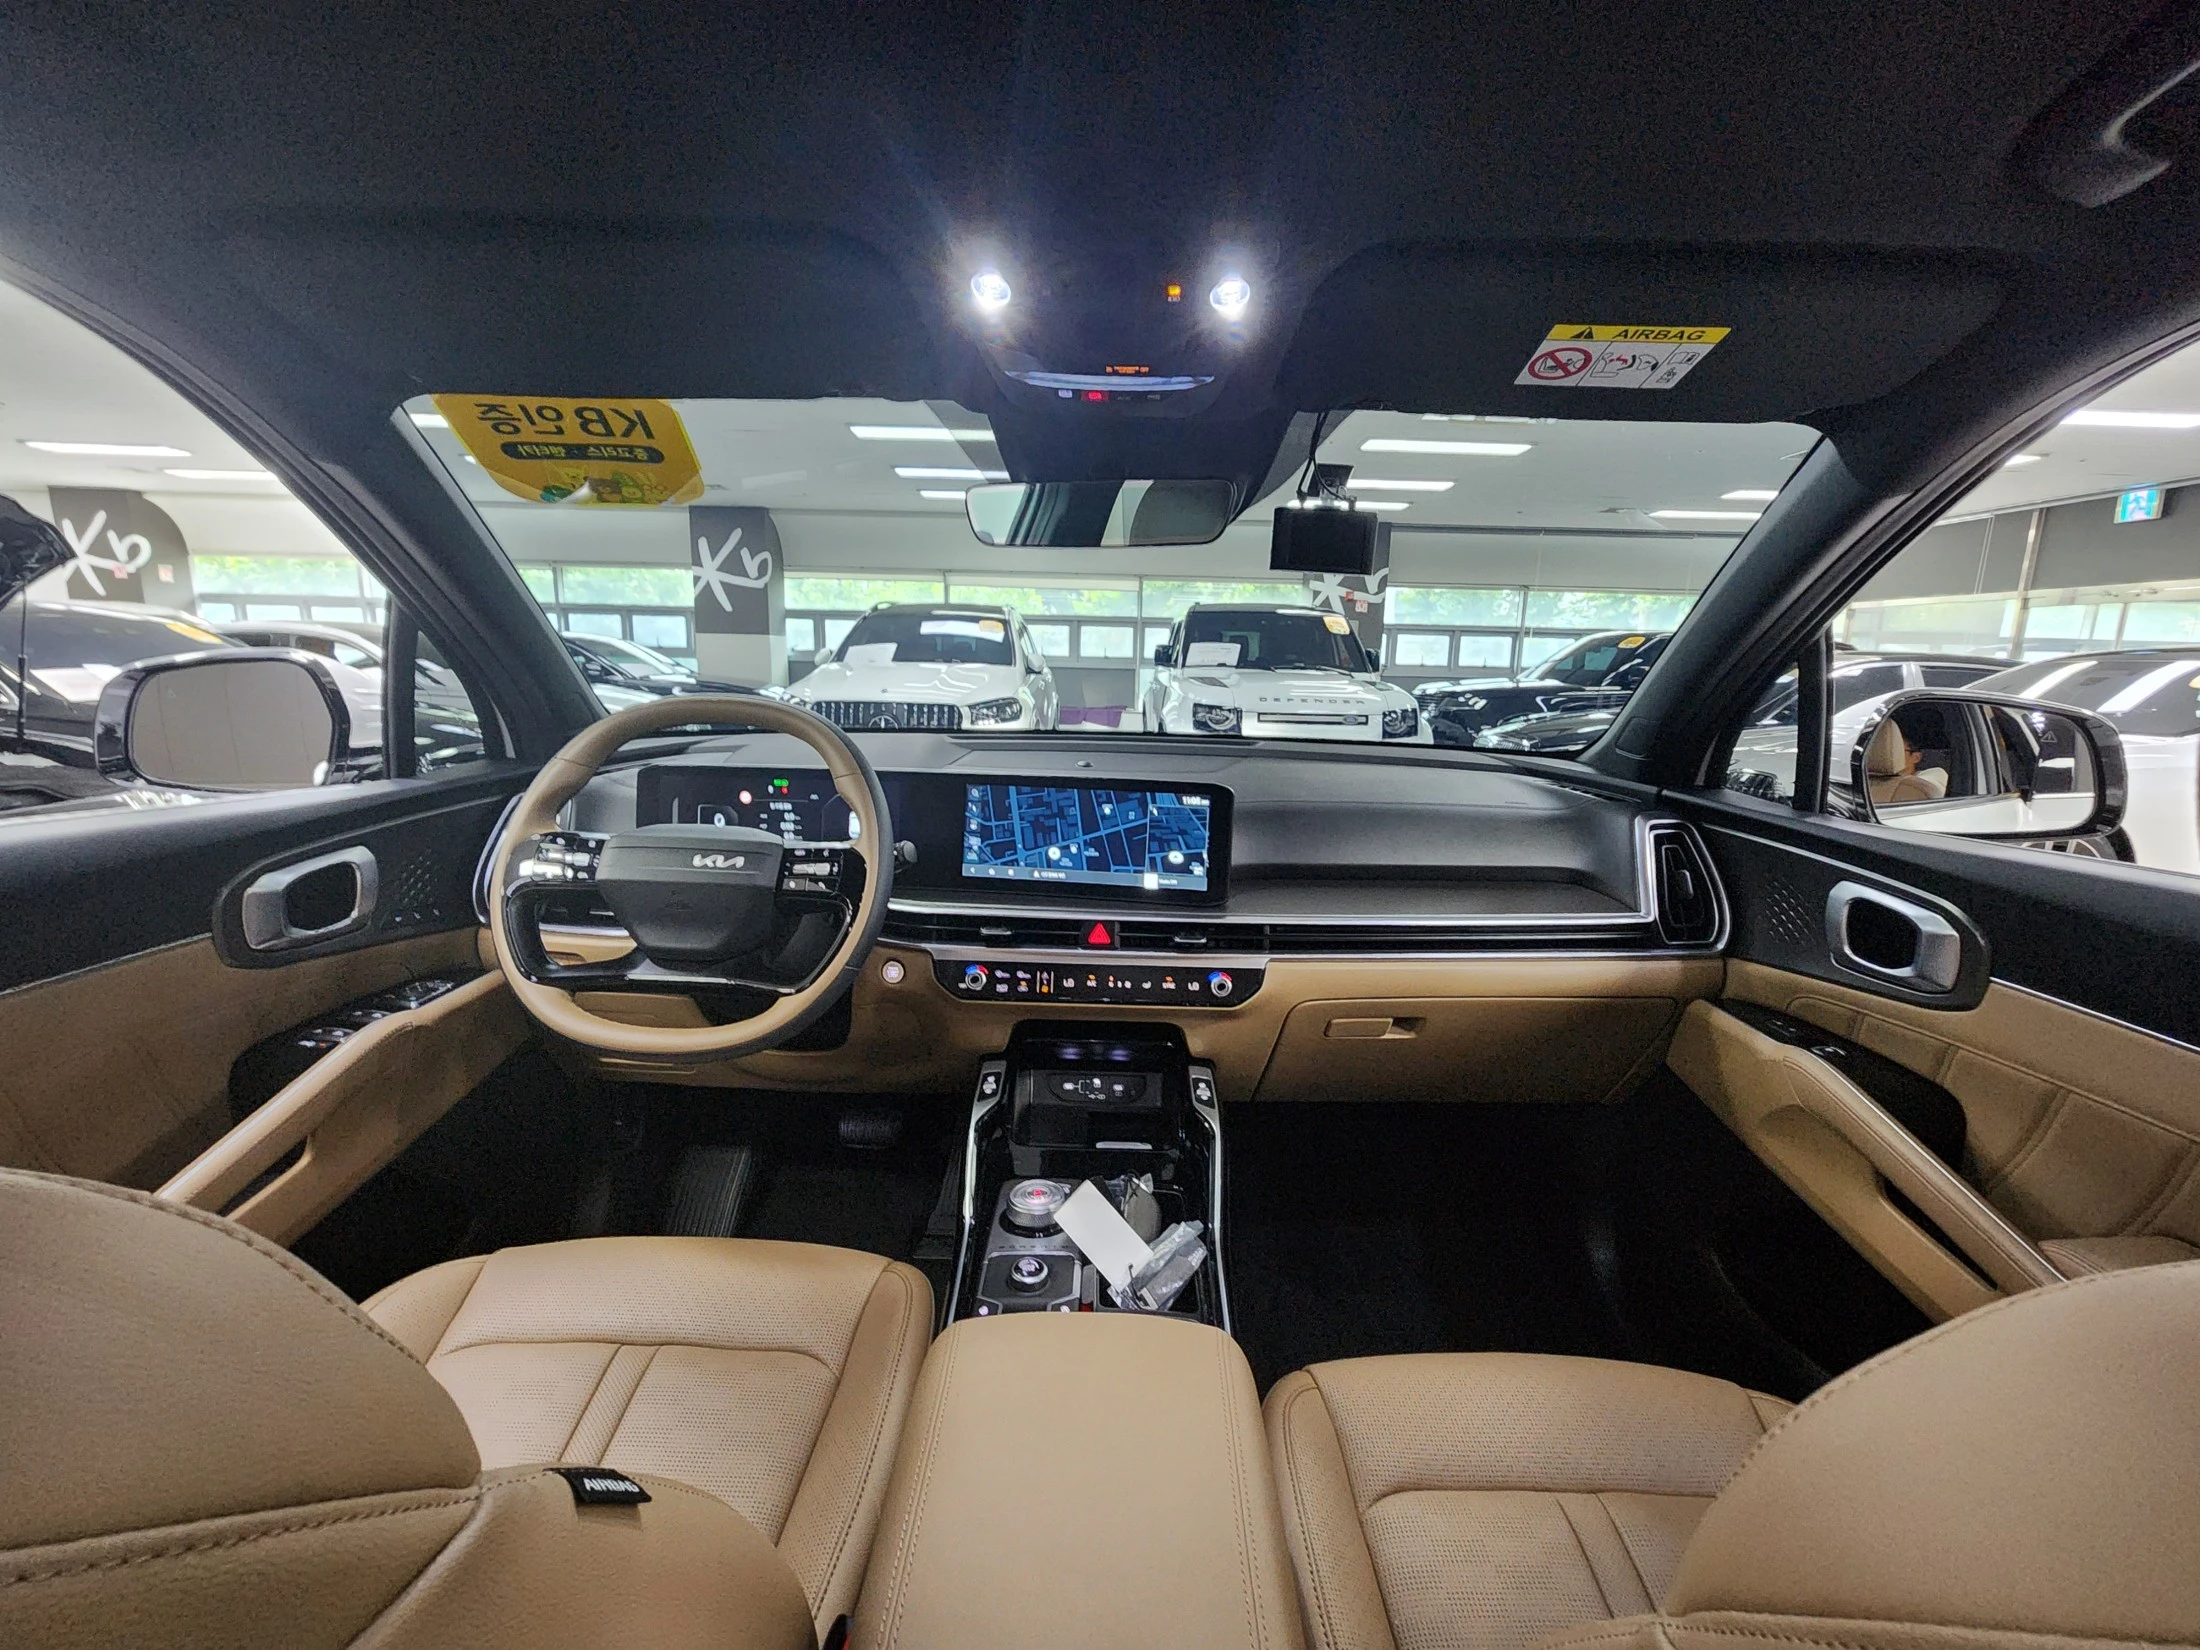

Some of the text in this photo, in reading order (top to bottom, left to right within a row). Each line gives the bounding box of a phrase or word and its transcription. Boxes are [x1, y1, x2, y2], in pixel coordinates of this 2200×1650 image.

[1612, 328, 1706, 342] AIRBAG
[1258, 696, 1367, 705] DEFENDER
[583, 1477, 640, 1493] AIRBAG
